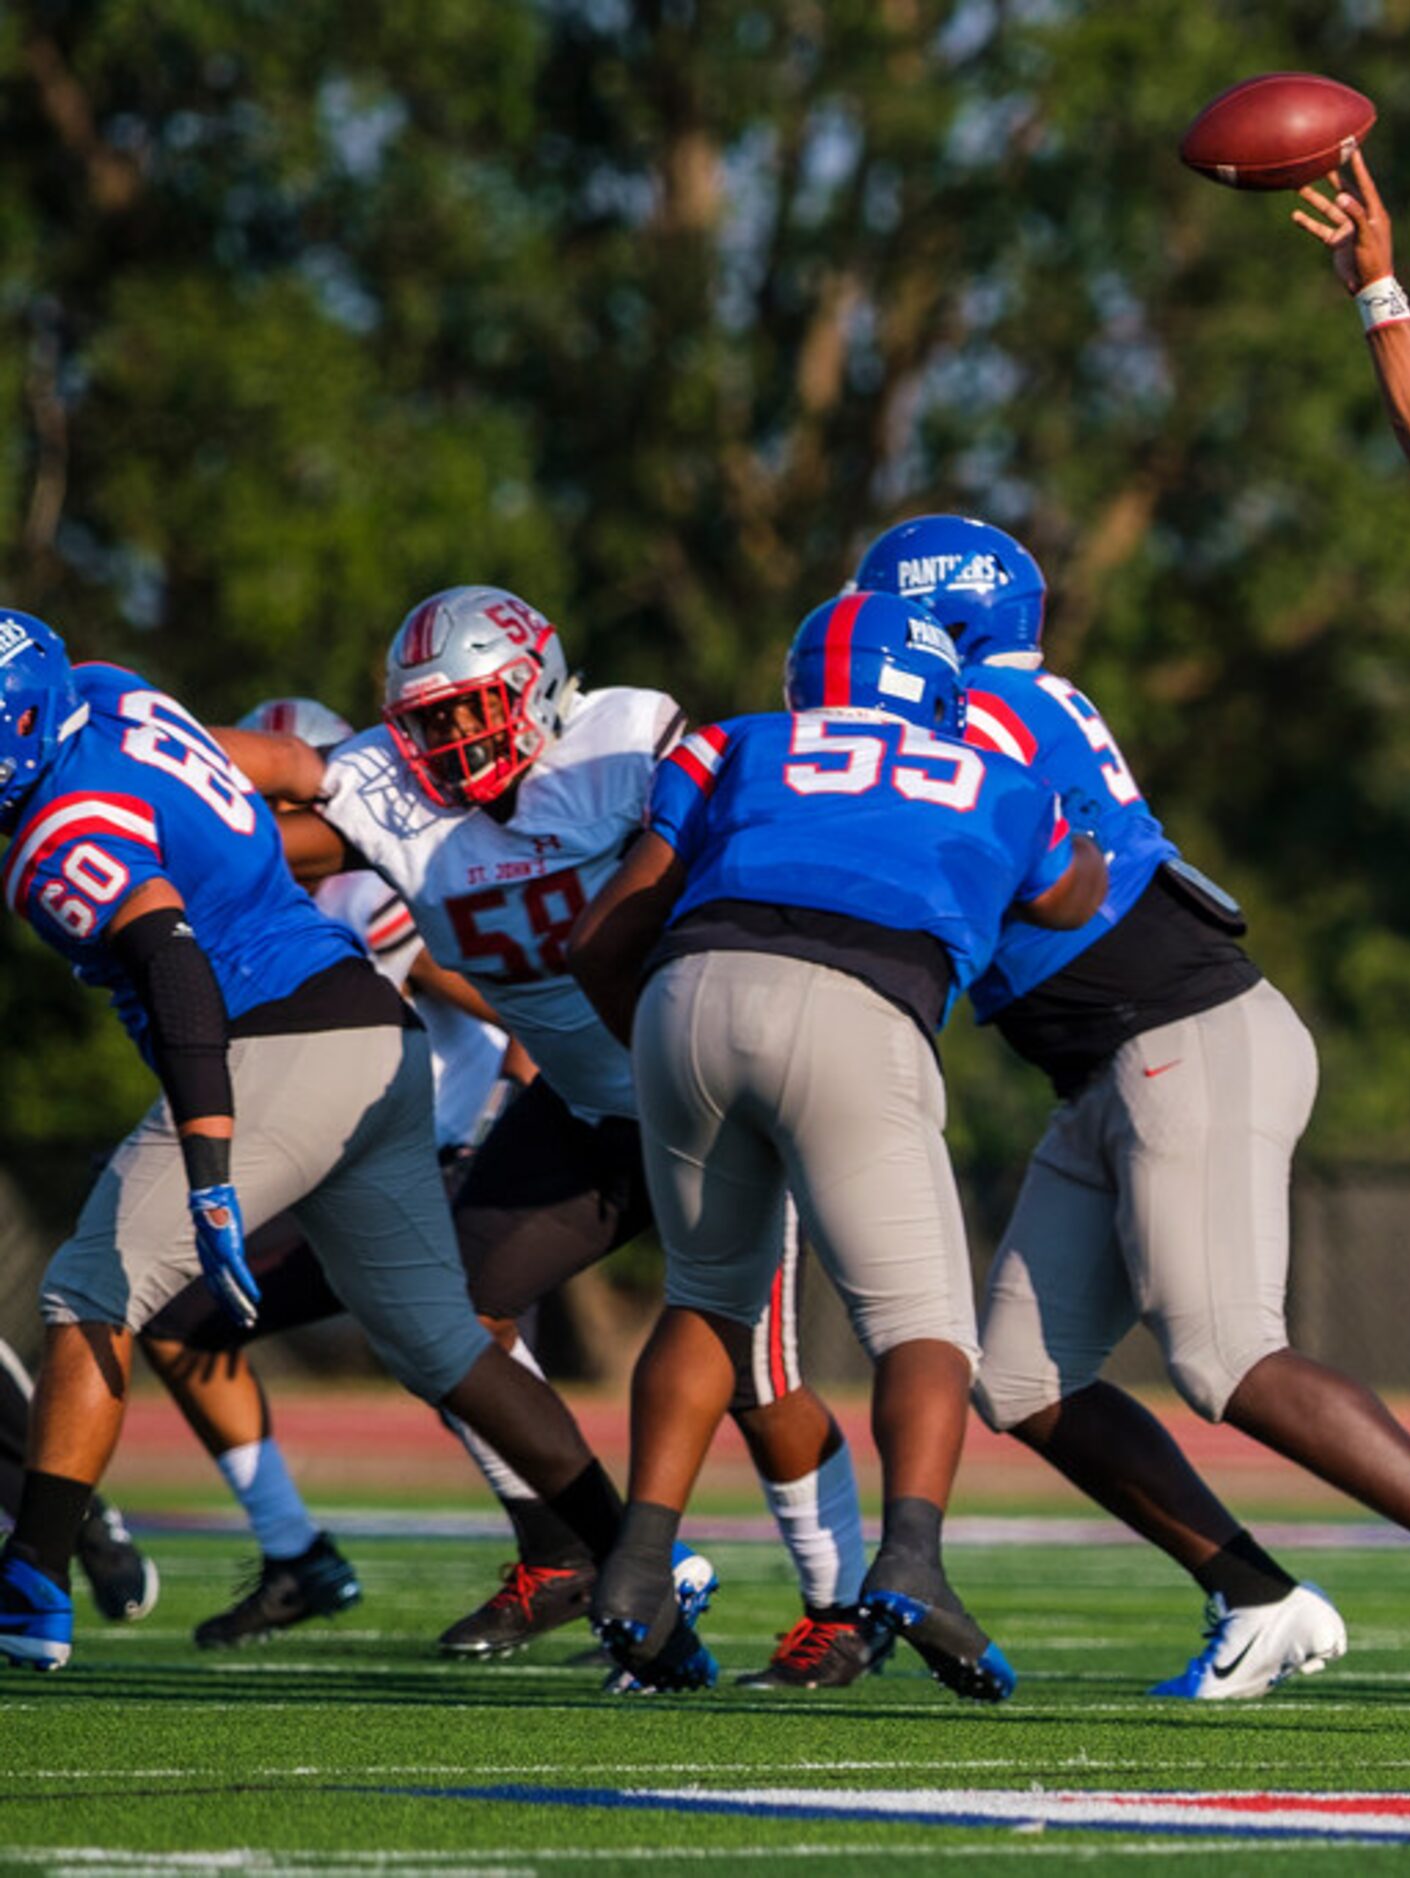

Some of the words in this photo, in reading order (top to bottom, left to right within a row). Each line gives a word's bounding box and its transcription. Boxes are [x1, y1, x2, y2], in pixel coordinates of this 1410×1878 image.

[119, 690, 255, 837] 60
[784, 704, 986, 813] 55
[38, 841, 130, 938] 60
[445, 868, 588, 986] 58
